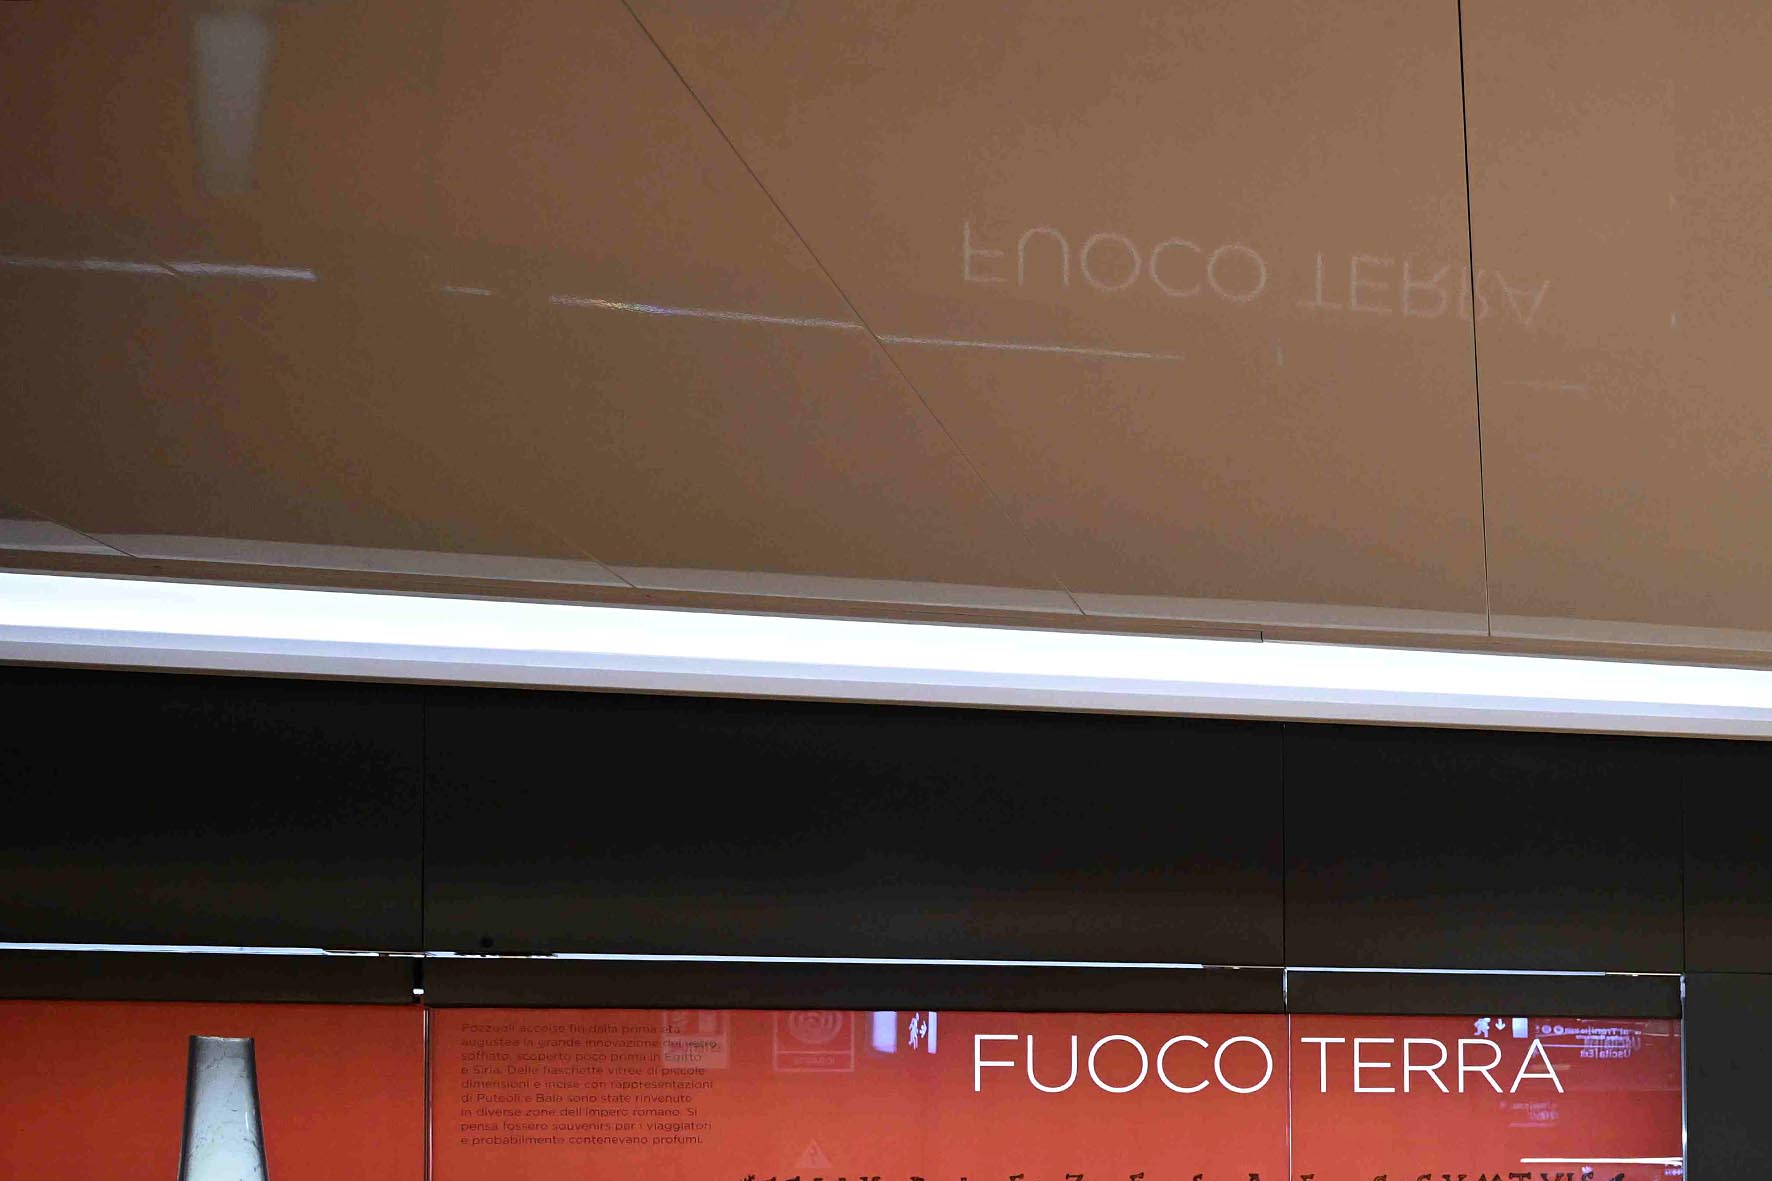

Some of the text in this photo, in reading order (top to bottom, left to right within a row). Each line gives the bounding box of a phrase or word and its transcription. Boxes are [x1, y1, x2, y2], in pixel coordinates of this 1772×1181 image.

[973, 1034, 1564, 1094] FUOCO TERRA
[535, 1093, 563, 1103] Baia
[568, 1135, 649, 1145] contenevano
